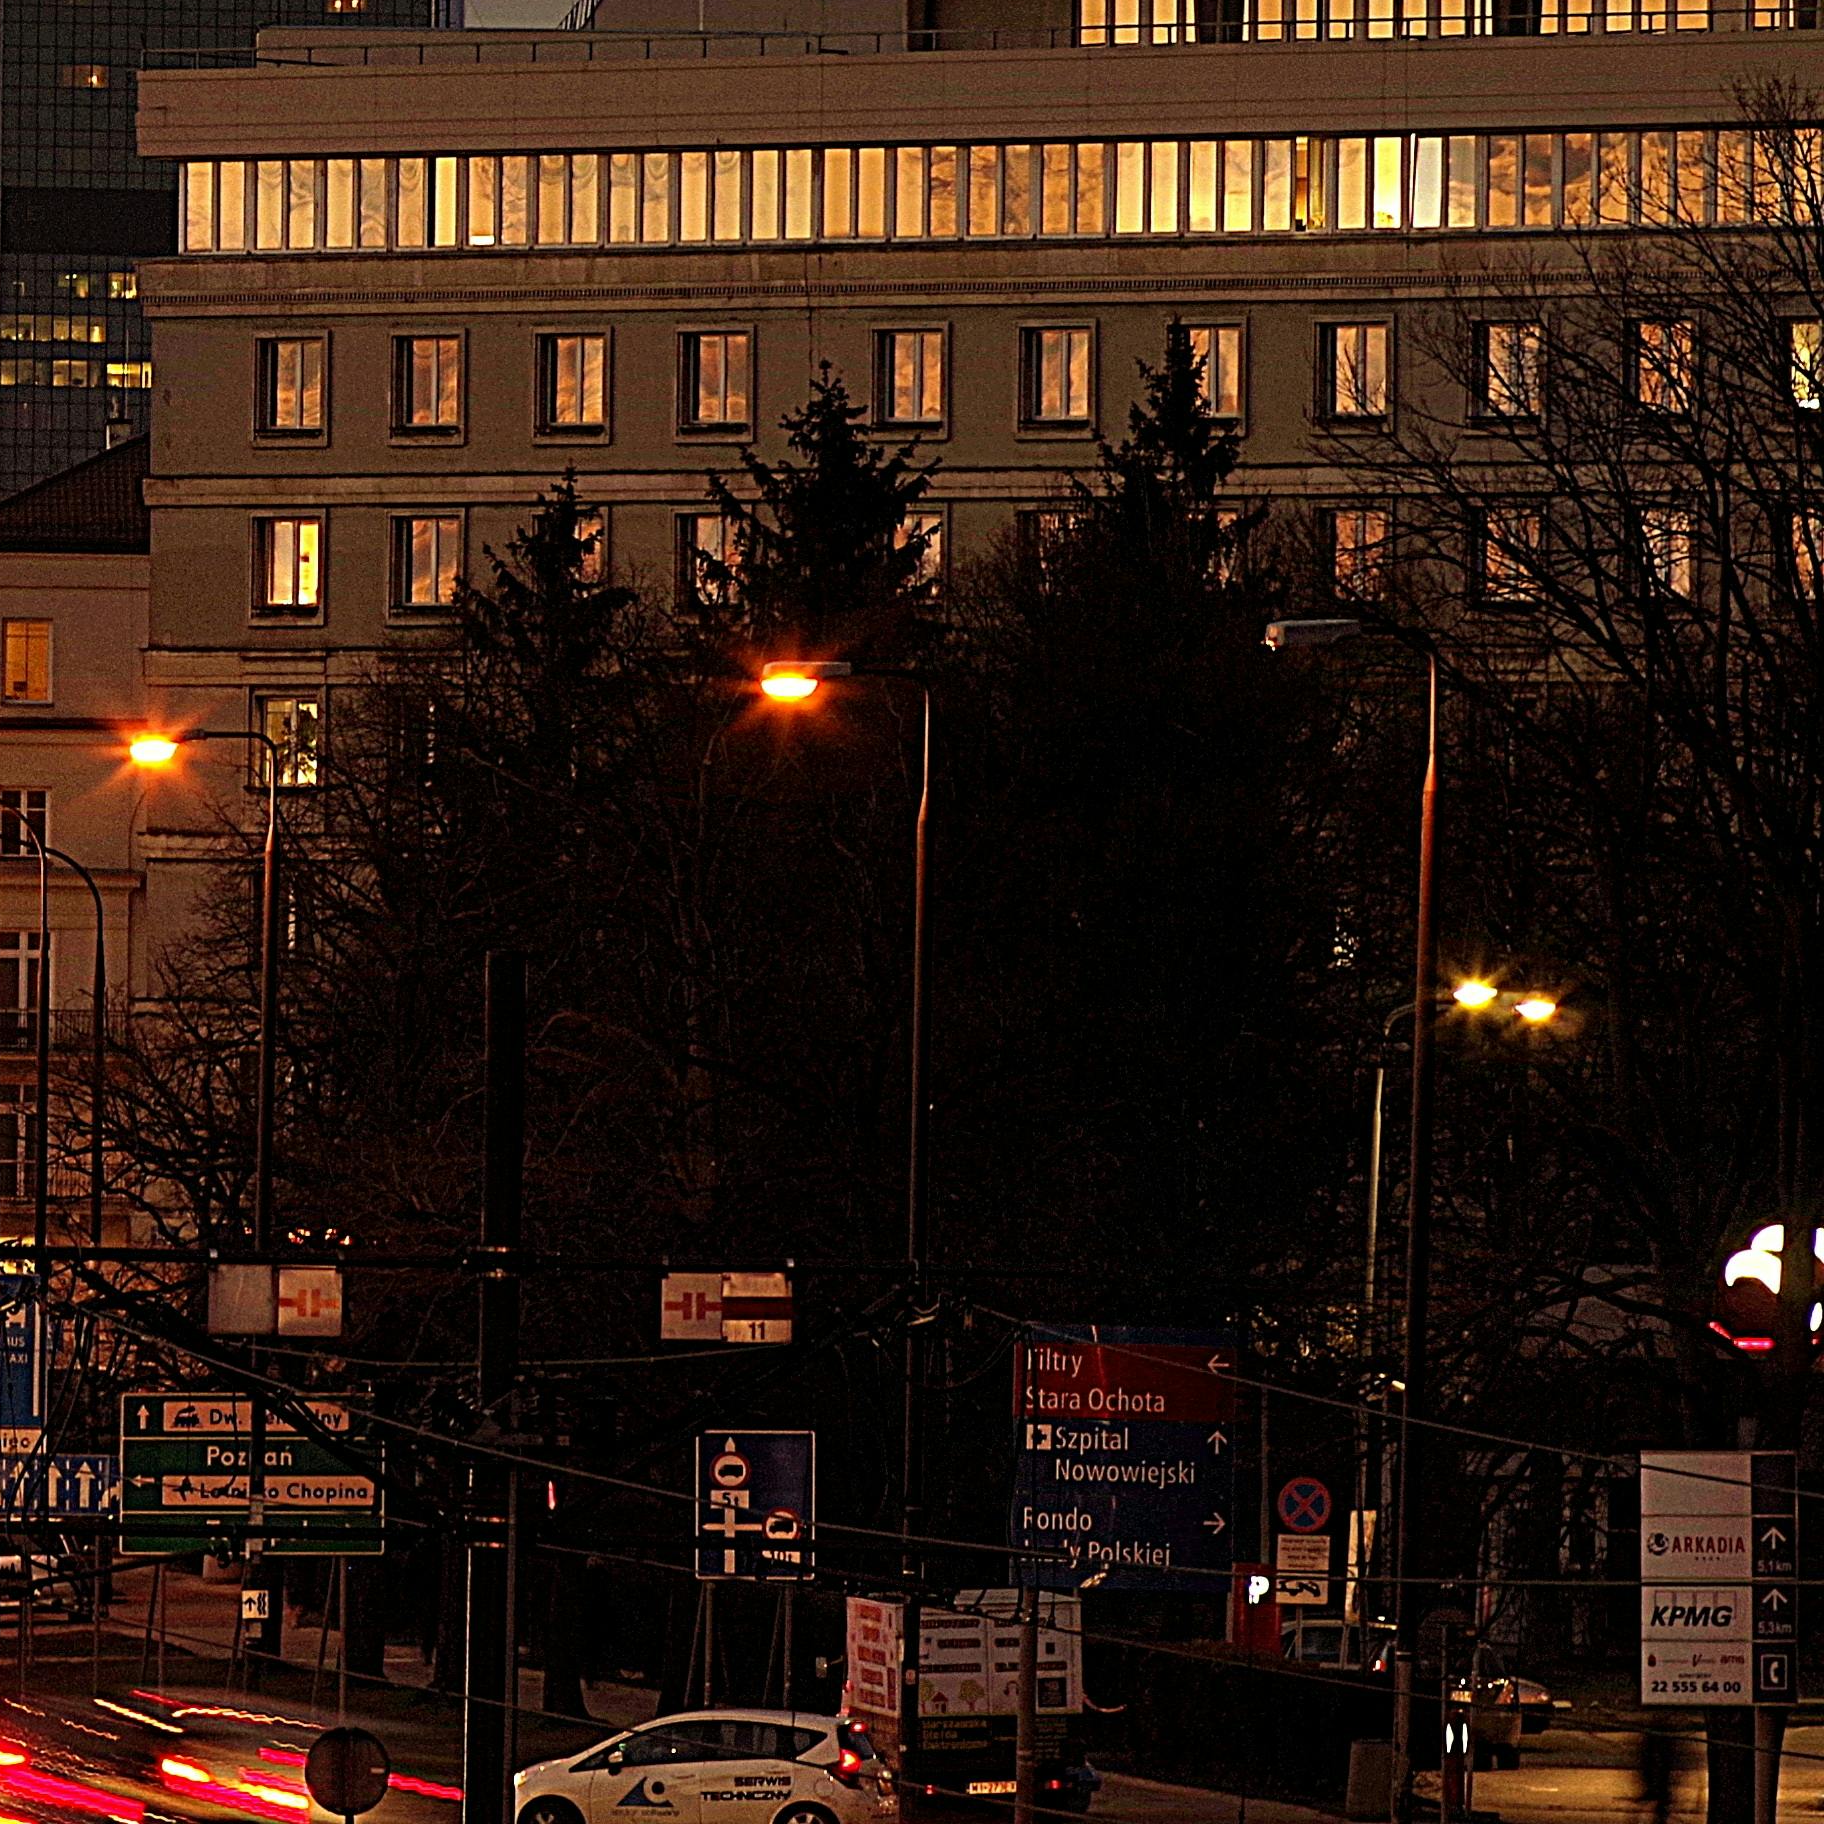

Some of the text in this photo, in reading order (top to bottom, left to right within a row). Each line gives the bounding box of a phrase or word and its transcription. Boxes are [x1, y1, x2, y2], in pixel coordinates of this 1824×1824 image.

[748, 1321, 766, 1341] 11
[1026, 1385, 1166, 1413] Stara Ochota
[1055, 1426, 1129, 1456] Szpital
[206, 1444, 293, 1466] Pozań
[1055, 1458, 1196, 1490] Nowowiejski
[286, 1482, 369, 1503] Chopina
[1088, 1540, 1171, 1567] Polskiej
[1671, 1536, 1746, 1554] ARKADIA
[1650, 1605, 1734, 1627] KPMG
[1652, 1681, 1741, 1693] 22 555 64 00
[734, 1776, 792, 1788] SERWIS
[700, 1791, 793, 1802] TECHNICZNY
